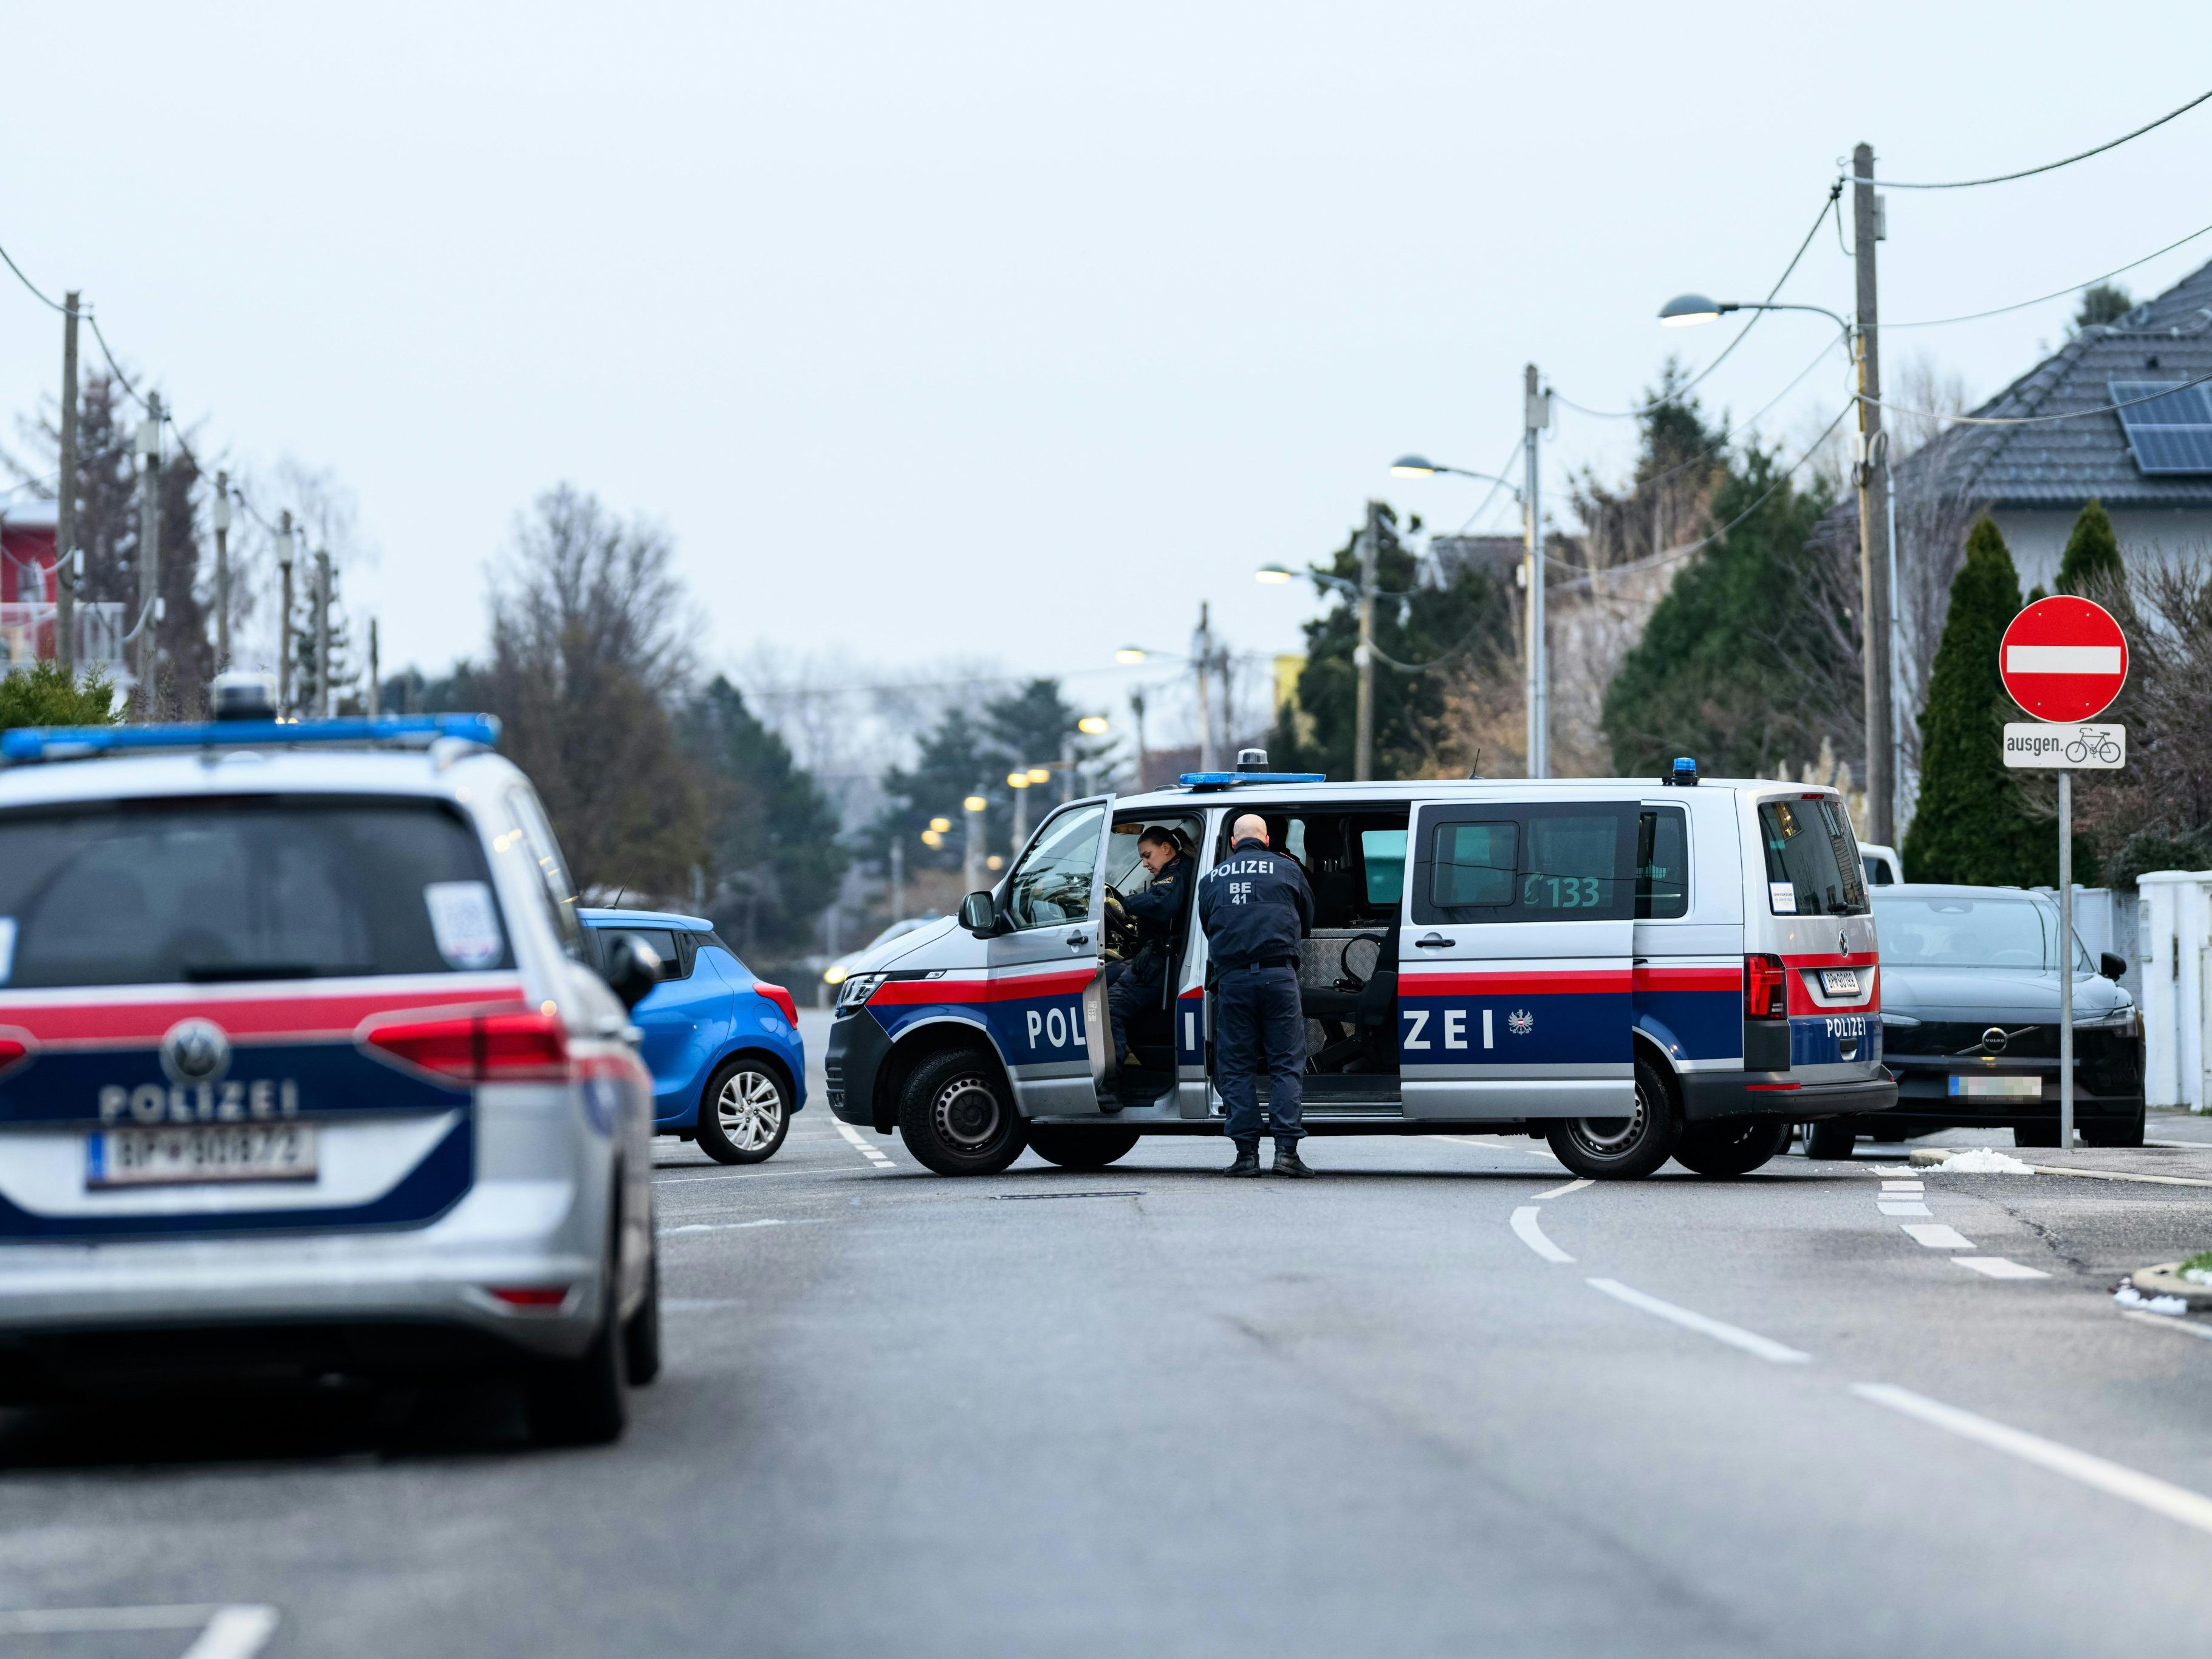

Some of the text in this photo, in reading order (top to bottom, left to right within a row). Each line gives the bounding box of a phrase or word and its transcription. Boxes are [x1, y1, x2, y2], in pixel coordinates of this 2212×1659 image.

[2007, 737, 2063, 756] ausgen.
[1210, 860, 1273, 883] POLIZEI
[1230, 882, 1252, 894] BE
[1547, 877, 1599, 907] 133
[1231, 894, 1247, 905] 41
[1403, 1010, 1493, 1049] ZEI
[1826, 1017, 1866, 1038] POLIZEI
[99, 1079, 299, 1124] POLIZEI
